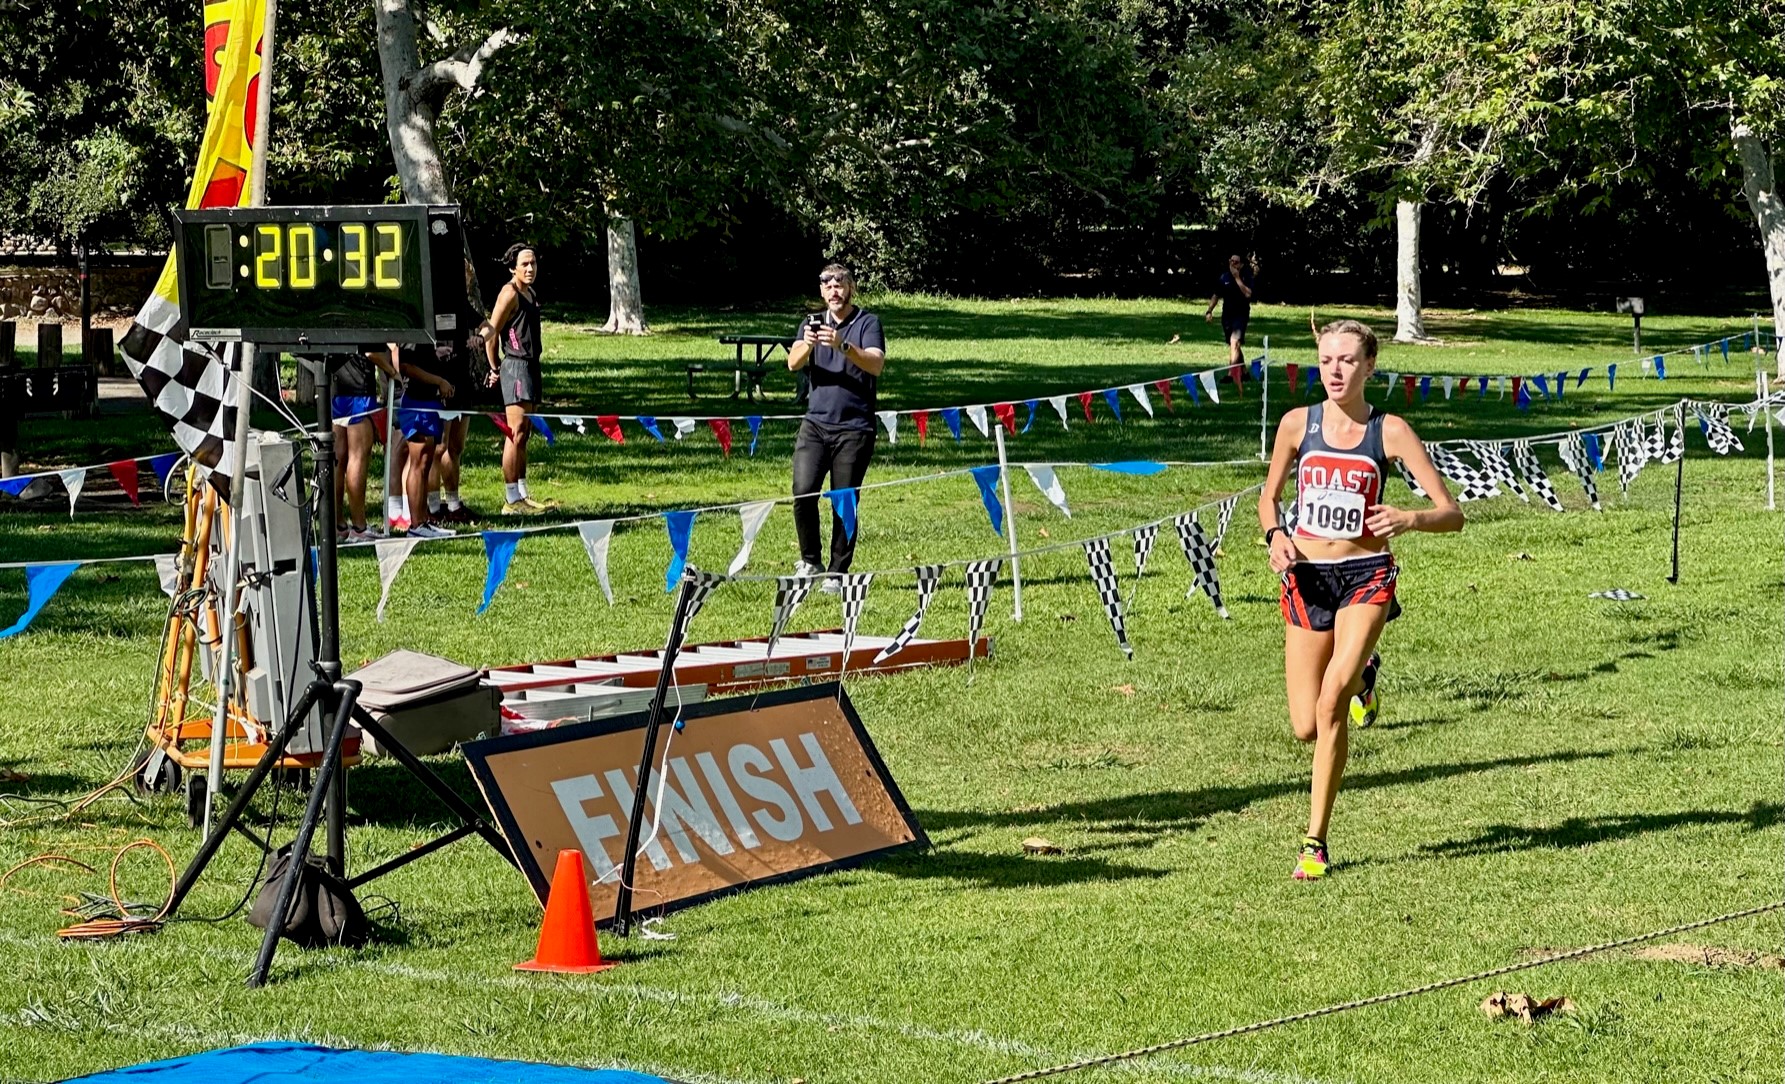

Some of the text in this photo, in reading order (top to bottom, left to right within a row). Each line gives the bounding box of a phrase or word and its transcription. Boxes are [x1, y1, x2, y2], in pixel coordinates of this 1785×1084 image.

[1301, 466, 1376, 494] COAST
[1306, 502, 1362, 533] 1099
[550, 732, 863, 885] FINISH
